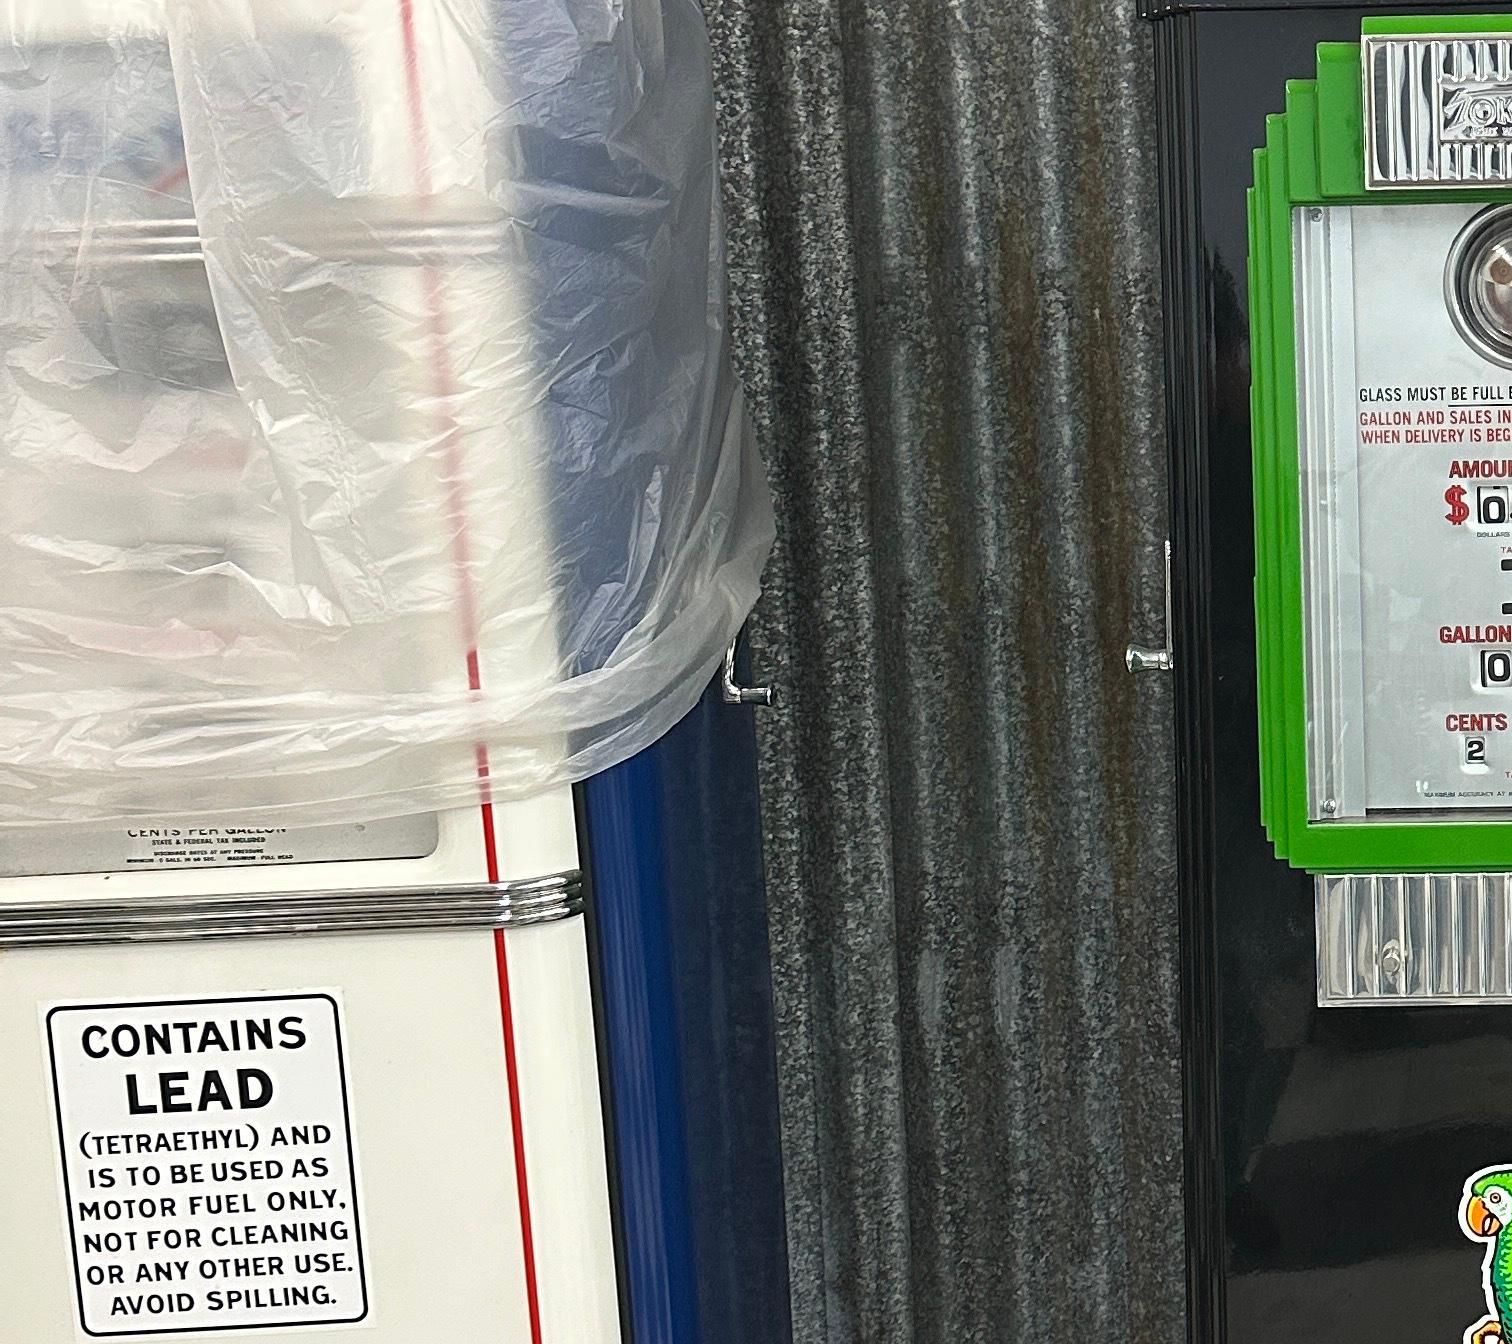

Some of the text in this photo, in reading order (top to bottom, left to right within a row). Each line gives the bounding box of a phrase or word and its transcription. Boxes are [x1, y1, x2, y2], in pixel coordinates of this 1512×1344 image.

[1360, 388, 1401, 402] GLASS
[1407, 387, 1446, 401] MUST
[1451, 387, 1467, 400] BE
[1473, 386, 1504, 400] FULL
[1360, 411, 1411, 425] GALLON
[1417, 410, 1444, 425] AND
[1450, 410, 1492, 424] SALES
[1361, 430, 1400, 444] WHEN
[1405, 429, 1464, 443] DELIVERY
[1470, 428, 1481, 442] IS
[1446, 714, 1507, 732] CENTS
[1468, 740, 1484, 760] 2
[81, 1016, 307, 1059] CONTAINS
[125, 1067, 274, 1116] LEAD
[79, 1123, 331, 1159] (TETRAETHYL) AND
[88, 1157, 329, 1189] IS TO BE USED AS
[79, 1189, 347, 1221] MOTOR FUEL ONLY,
[84, 1221, 349, 1253] NOT FOR CLEANING
[86, 1252, 354, 1287] OR ANY OTHER USE.
[110, 1285, 337, 1316] AVOID SPILLING.
